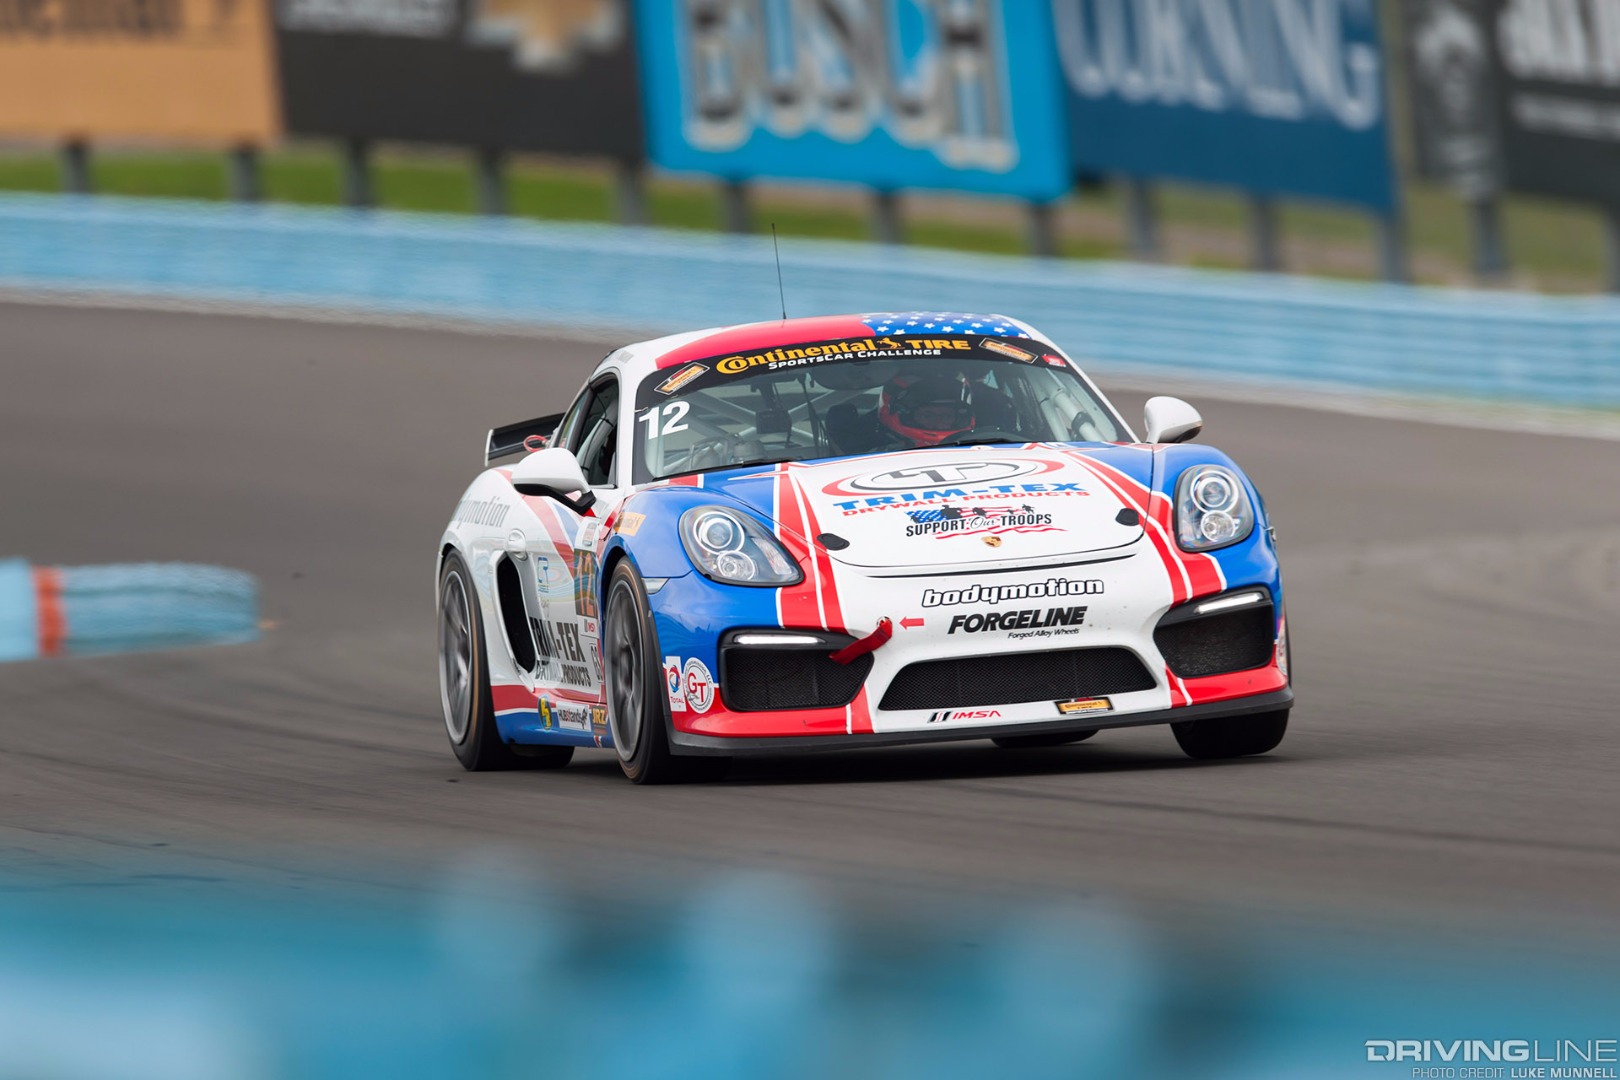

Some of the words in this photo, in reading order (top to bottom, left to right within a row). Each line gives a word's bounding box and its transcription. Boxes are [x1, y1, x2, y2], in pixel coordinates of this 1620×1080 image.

[715, 338, 878, 375] Continental
[905, 339, 972, 350] TIRE
[768, 352, 854, 370] SPORTSCAR
[857, 348, 942, 358] CHALLENGE
[638, 400, 690, 440] 12
[832, 482, 1088, 511] TRIM-TEX
[842, 498, 957, 516] DRYWALL
[962, 491, 1091, 501] PRODUCTS
[905, 518, 967, 537] SUPPORT
[969, 516, 999, 530] Our
[1000, 513, 1053, 527] TROOPS
[921, 578, 1104, 608] bodymotion
[947, 605, 1088, 635] FORGELINE
[1007, 630, 1035, 640] Forged
[1034, 629, 1054, 638] Alloy
[1054, 627, 1080, 635] Wheels
[687, 672, 707, 703] GT
[952, 710, 1002, 720] IMSA
